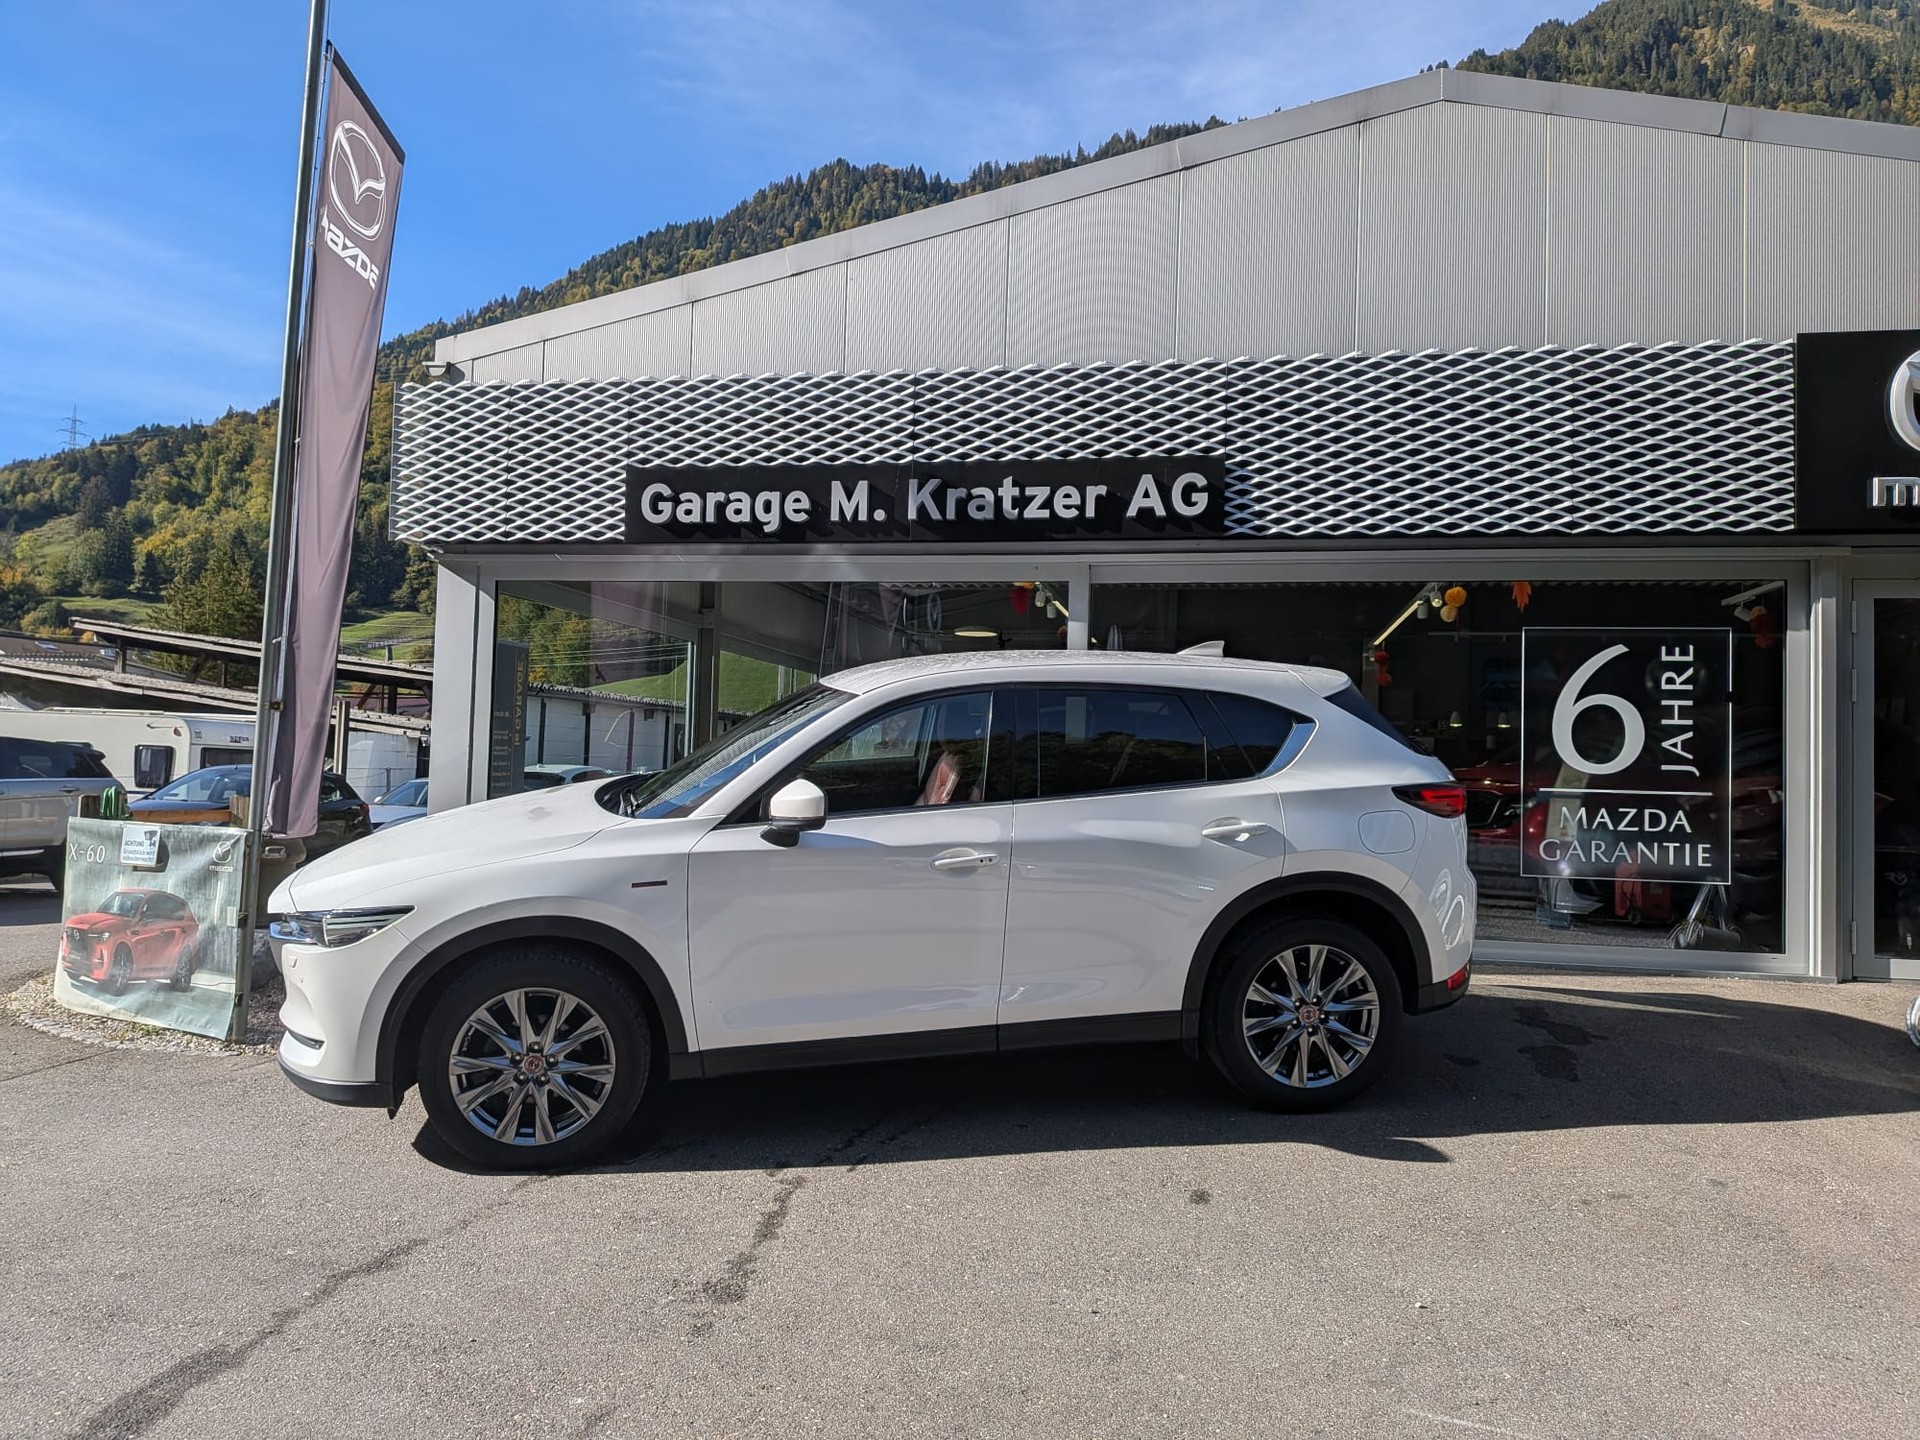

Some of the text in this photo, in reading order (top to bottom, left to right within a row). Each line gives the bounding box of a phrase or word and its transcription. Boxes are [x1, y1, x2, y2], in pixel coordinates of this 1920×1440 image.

[640, 472, 1210, 534] Garage M. Kratzer AG
[1551, 643, 1646, 775] 6
[1660, 644, 1700, 778] JAHRE
[1559, 806, 1692, 833] MAZDA
[1538, 838, 1713, 867] GARANTIE
